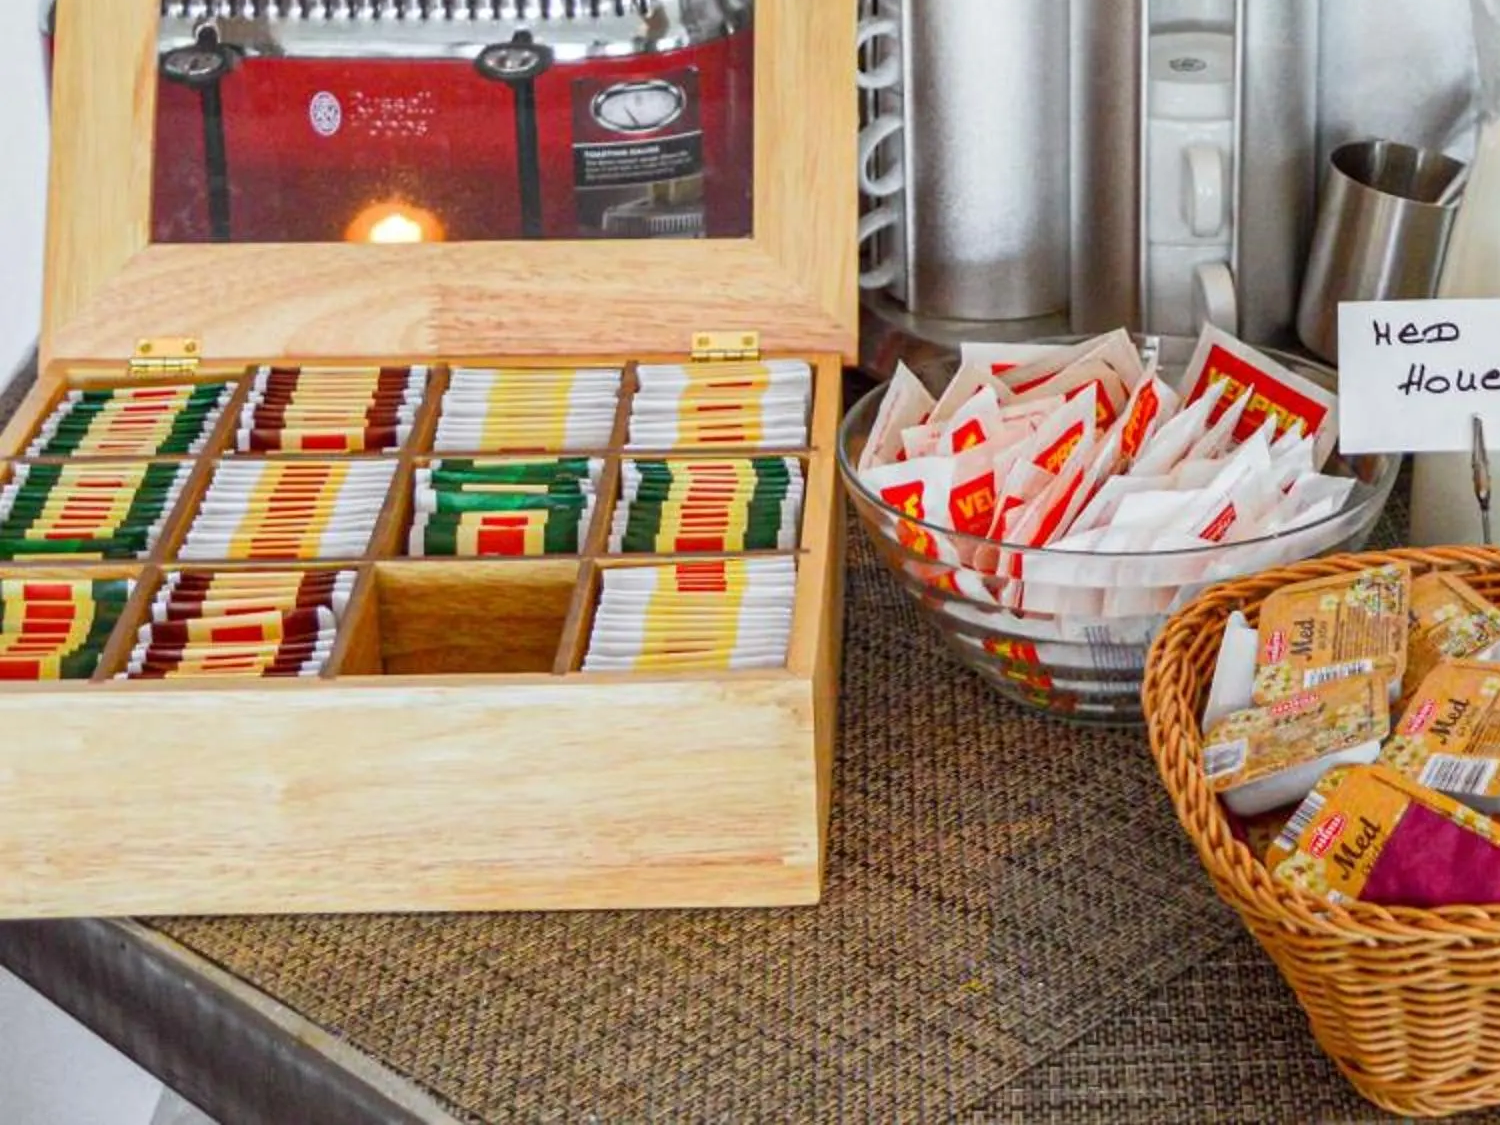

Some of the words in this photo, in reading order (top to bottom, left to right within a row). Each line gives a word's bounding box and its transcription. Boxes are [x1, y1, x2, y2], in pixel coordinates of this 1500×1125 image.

[1290, 616, 1315, 661] Med
[1428, 698, 1471, 747] Med
[1332, 816, 1382, 881] Med
